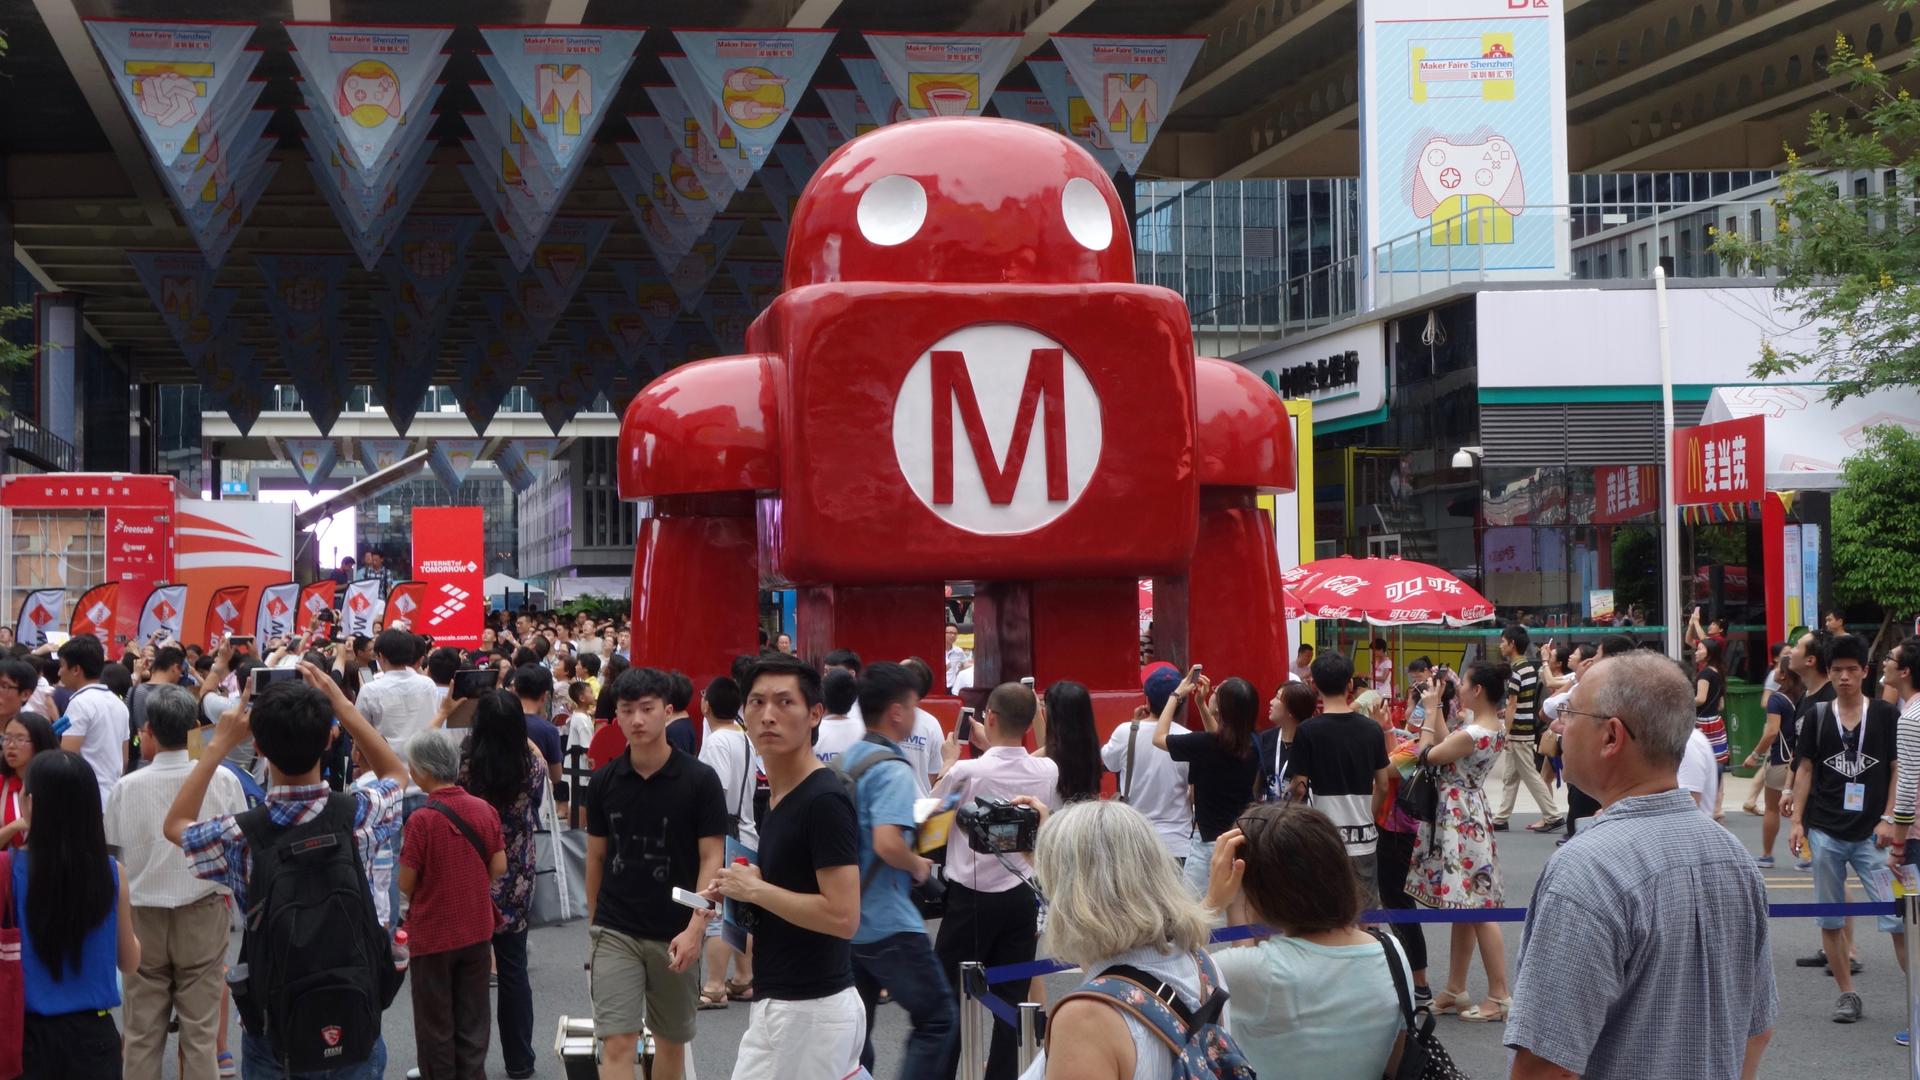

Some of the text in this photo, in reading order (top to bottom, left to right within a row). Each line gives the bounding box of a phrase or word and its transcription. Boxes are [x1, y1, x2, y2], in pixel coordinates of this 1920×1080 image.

[758, 40, 793, 49] Shenzhen
[1133, 46, 1166, 55] Shenzhen
[1420, 60, 1513, 70] Maker Faire Shenzhen
[930, 348, 1069, 505] M
[1704, 435, 1747, 493] 麦当劳
[123, 525, 154, 534] freescale
[1389, 608, 1433, 620] 可口可乐
